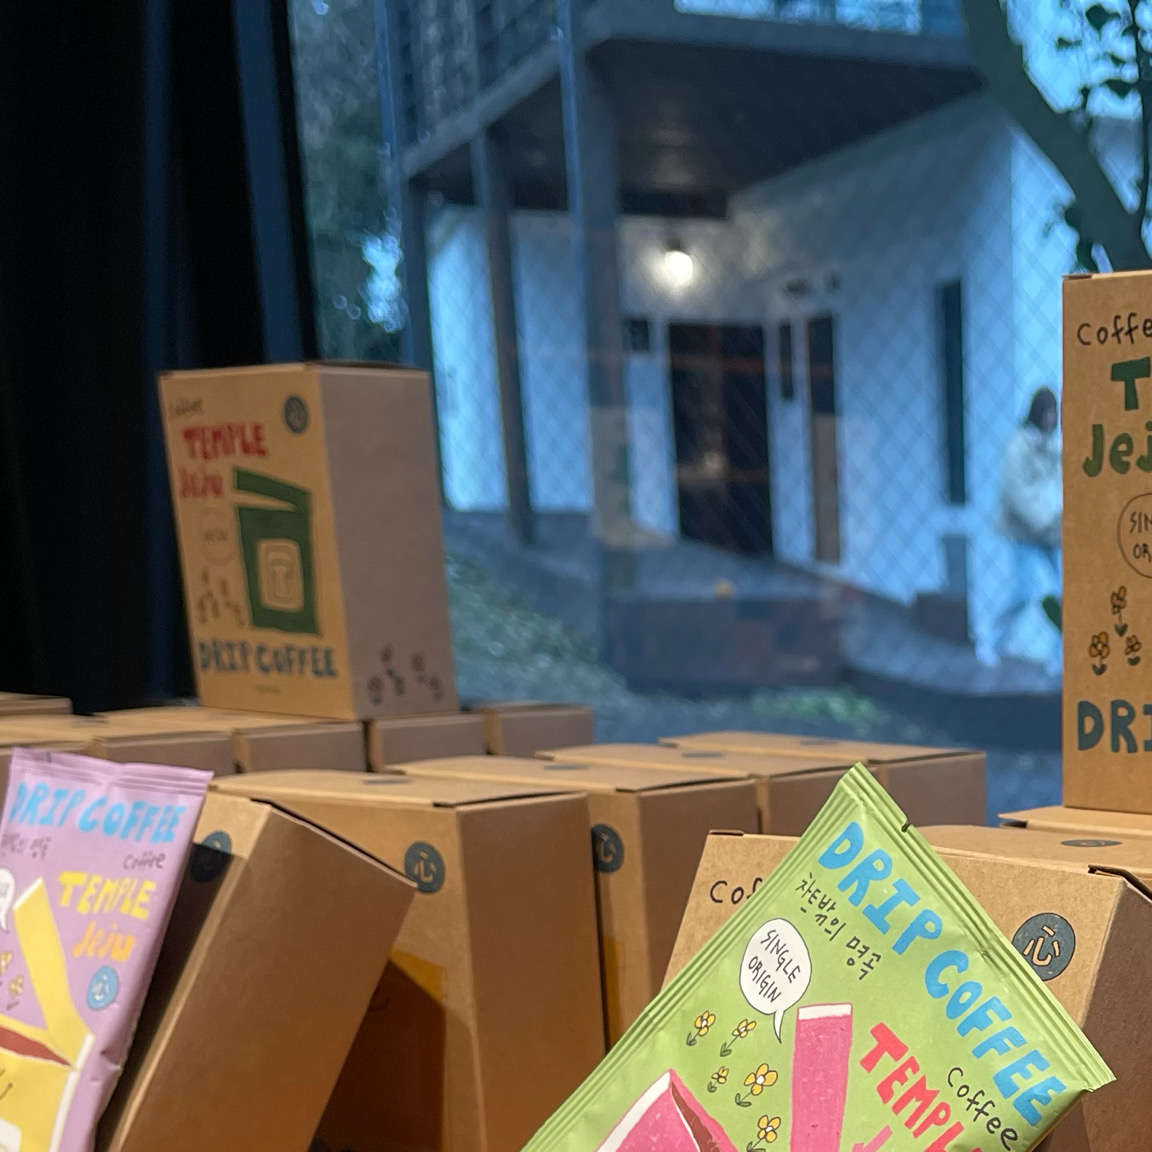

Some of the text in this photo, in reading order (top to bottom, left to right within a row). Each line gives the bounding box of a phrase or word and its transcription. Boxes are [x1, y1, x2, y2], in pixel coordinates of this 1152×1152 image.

[183, 421, 269, 461] TEMPLE
[7, 782, 187, 843] DRIP COFFEE
[747, 955, 782, 1004] ORIGIN
[763, 929, 801, 985] SINGLE
[817, 821, 1068, 1127] DRIP COFFEE
[846, 936, 883, 980] 명곡
[946, 1066, 1019, 1152] Coffee
